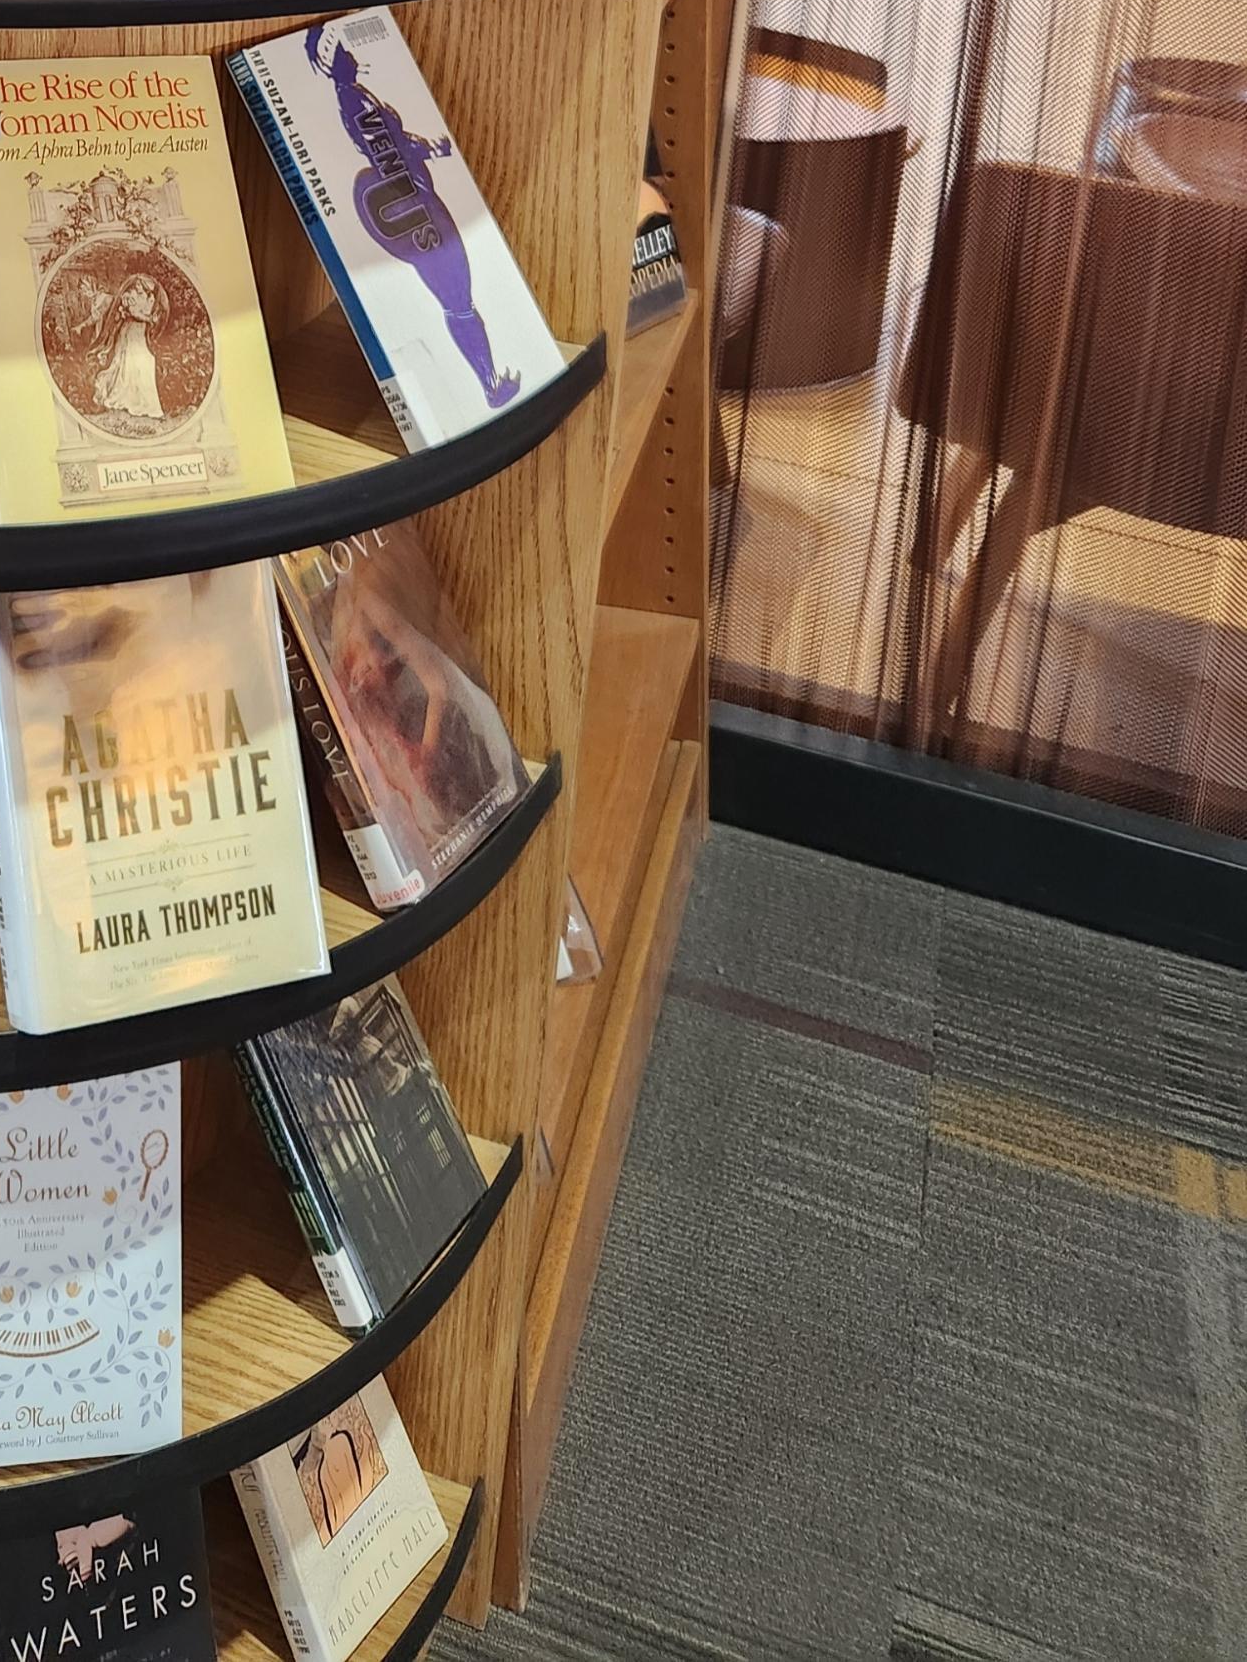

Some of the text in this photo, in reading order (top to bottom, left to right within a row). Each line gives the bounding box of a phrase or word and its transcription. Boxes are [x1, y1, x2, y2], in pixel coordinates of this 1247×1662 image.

[41, 70, 190, 101] Rise of the
[230, 54, 253, 87] VENUS
[93, 102, 209, 133] Novelist
[23, 140, 74, 165] Aphra
[75, 139, 111, 158] Behn
[114, 140, 127, 156] to
[127, 138, 157, 161] Jane
[157, 135, 209, 154] Austen
[242, 85, 320, 227] SUZAN-LORI PARKS
[263, 78, 336, 217] SUZAN-LORI PARKS
[352, 109, 443, 252] VENUS
[103, 460, 204, 489] Jane Spencer
[312, 528, 391, 589] LOVE
[61, 688, 252, 778] AGATHA
[45, 749, 278, 850] CHRISTIE
[105, 845, 251, 882] MYSTERIOUS LIFE
[76, 884, 276, 955] LAURA THOMPSON
[17, 1226, 65, 1239] Illustrated
[28, 1214, 85, 1224] Anniversary
[24, 1242, 58, 1252] Edition
[15, 1405, 65, 1434] May
[71, 1400, 124, 1424] Alcott
[26, 1437, 36, 1447] by
[45, 1434, 85, 1444] Courtney
[86, 1430, 119, 1441] Sullivan
[41, 1538, 160, 1603] SARAH
[10, 1574, 197, 1662] WATERS
